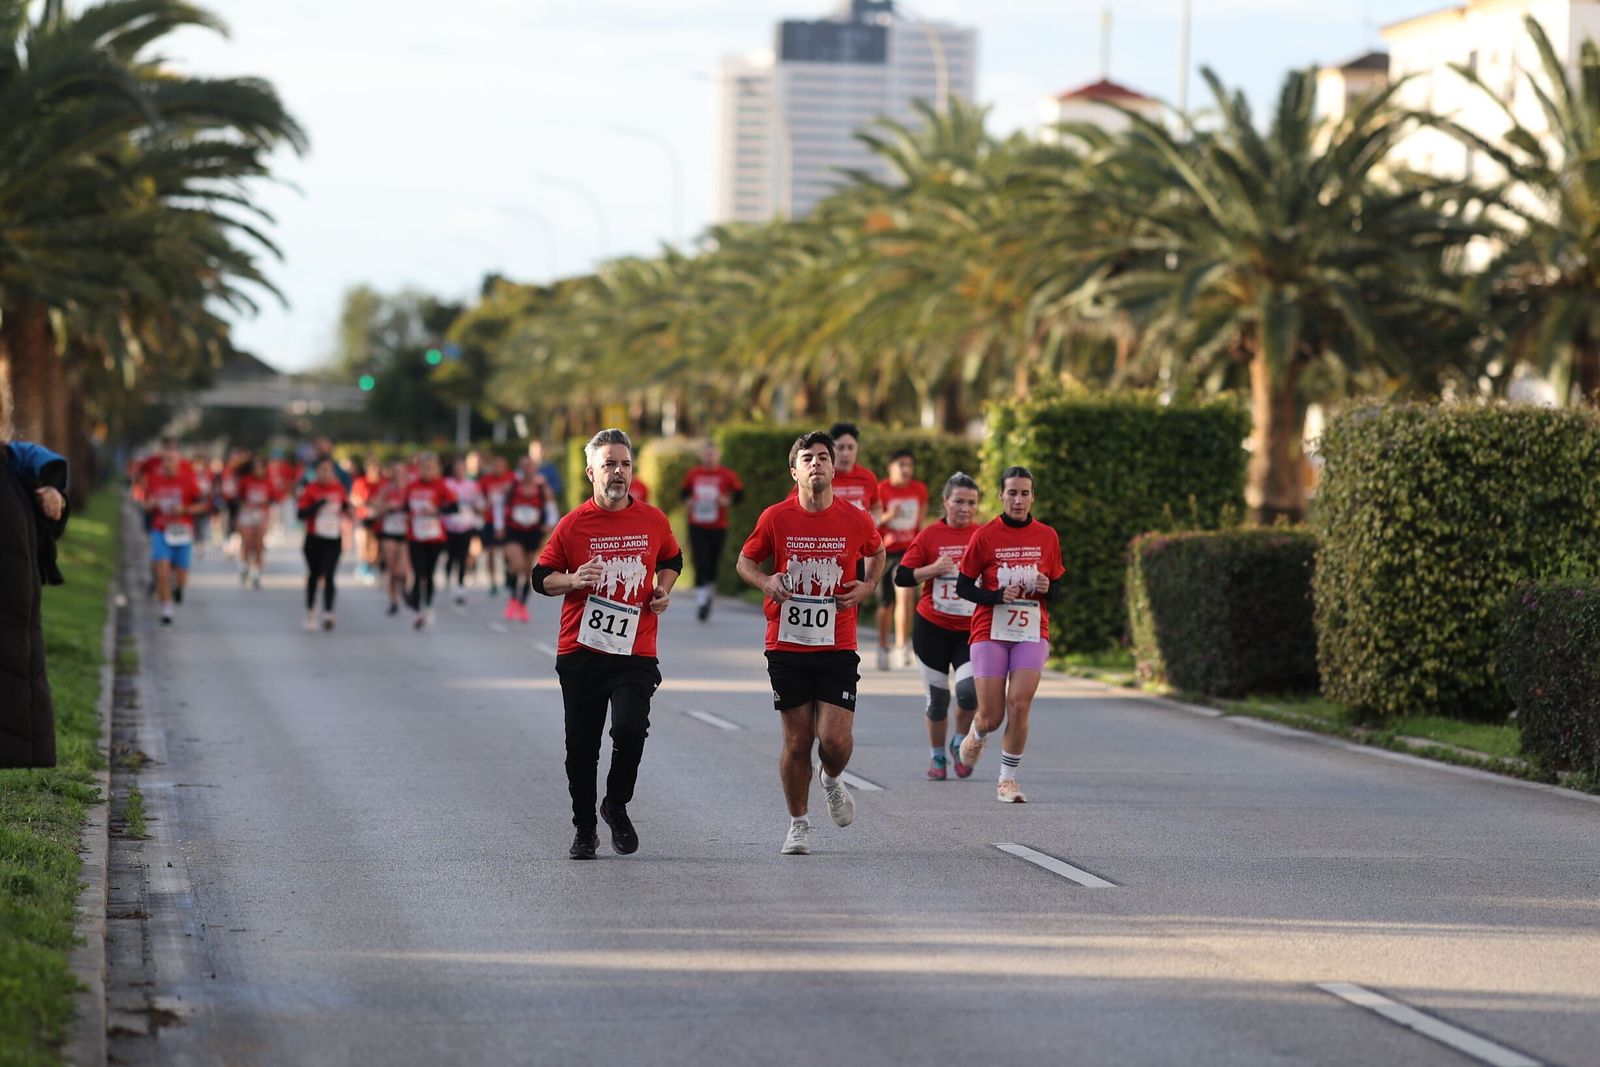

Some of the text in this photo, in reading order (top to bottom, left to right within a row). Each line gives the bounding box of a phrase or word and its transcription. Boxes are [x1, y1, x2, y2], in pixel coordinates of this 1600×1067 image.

[622, 539, 648, 548] JARDÍN
[588, 609, 629, 638] 811
[788, 606, 828, 628] 810
[1007, 610, 1029, 627] 75
